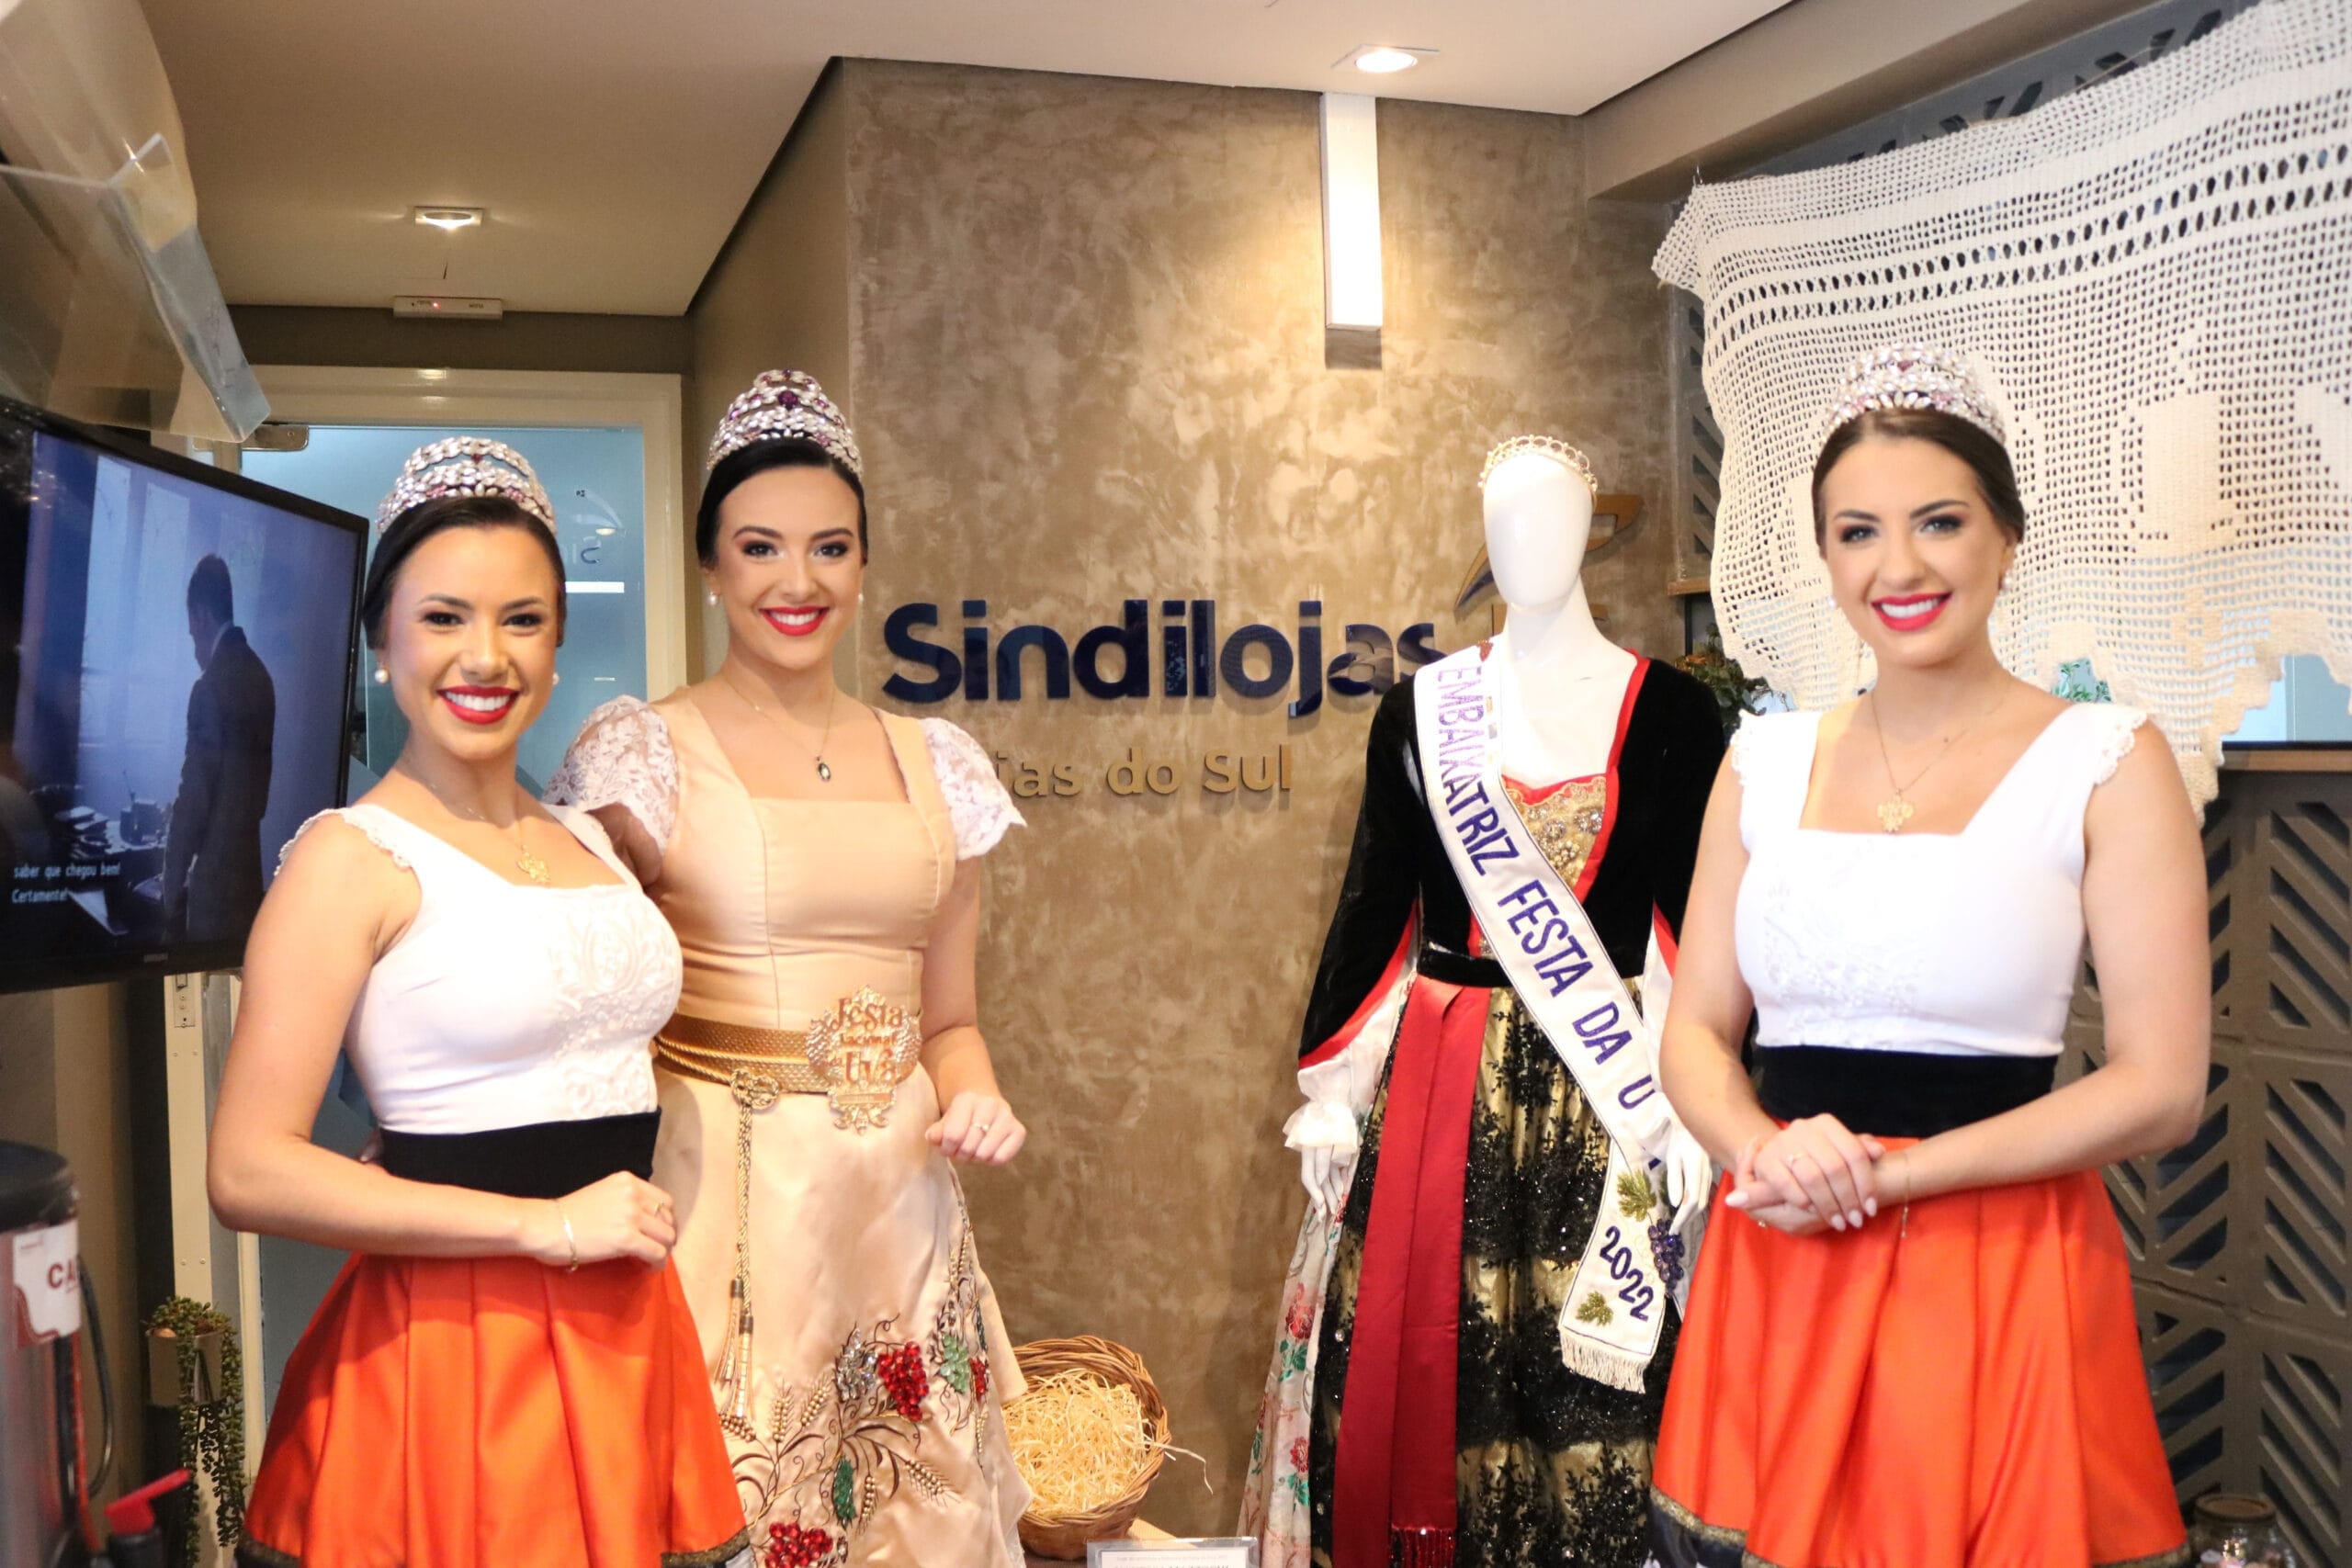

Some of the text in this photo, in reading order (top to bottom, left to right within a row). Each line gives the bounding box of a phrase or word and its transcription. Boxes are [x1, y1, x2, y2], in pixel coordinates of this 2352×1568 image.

[883, 600, 1447, 717] Sindilojas
[995, 744, 1293, 797] ias do Sul
[14, 863, 40, 878] saber
[44, 865, 61, 881] que
[65, 863, 97, 880] chegou
[1437, 665, 1657, 1110] EMBAIXATRIZ FESTA DA U
[1600, 1225, 1655, 1322] 2022
